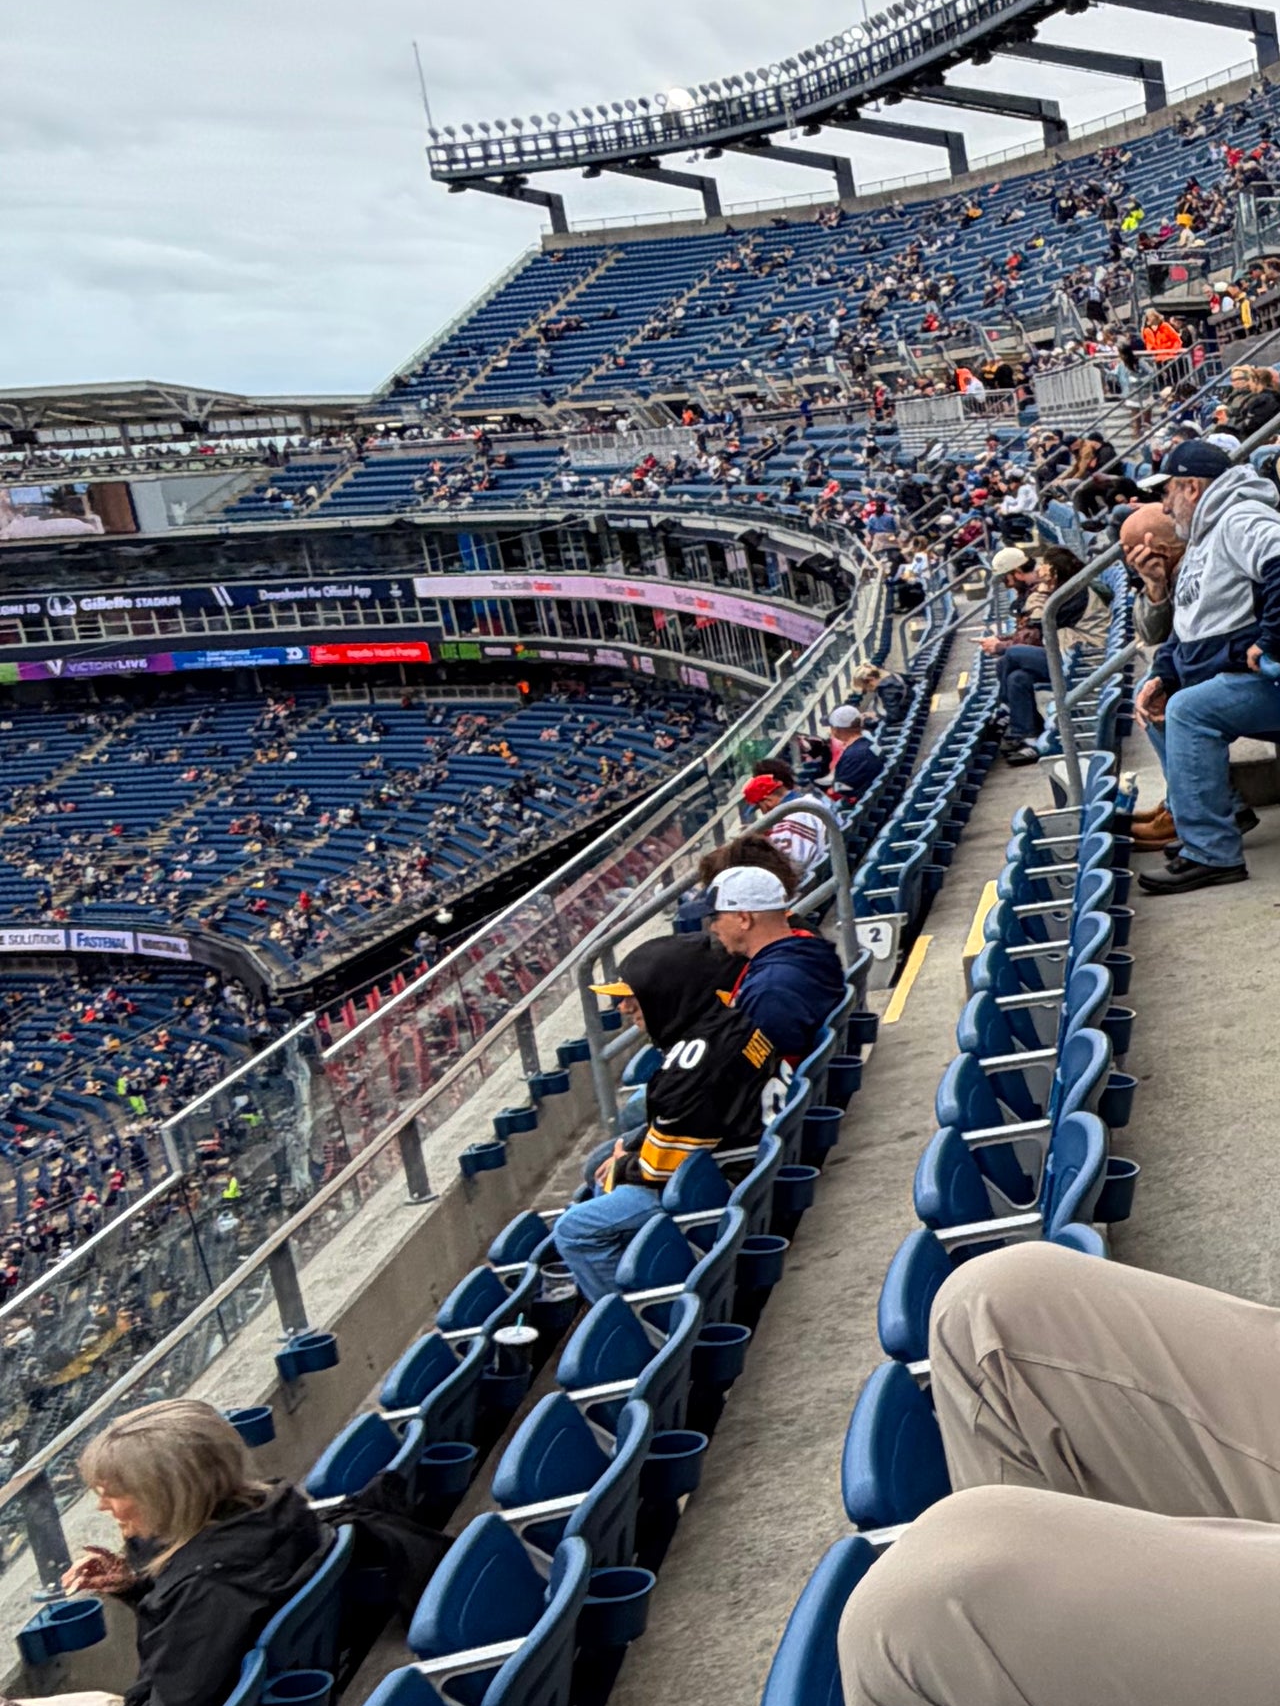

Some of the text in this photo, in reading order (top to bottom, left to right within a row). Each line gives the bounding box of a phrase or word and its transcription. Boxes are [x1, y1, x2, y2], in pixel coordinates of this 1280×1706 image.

[80, 595, 182, 611] Gillette STADIUM
[76, 931, 128, 950] FASTENAL
[869, 926, 883, 943] 2
